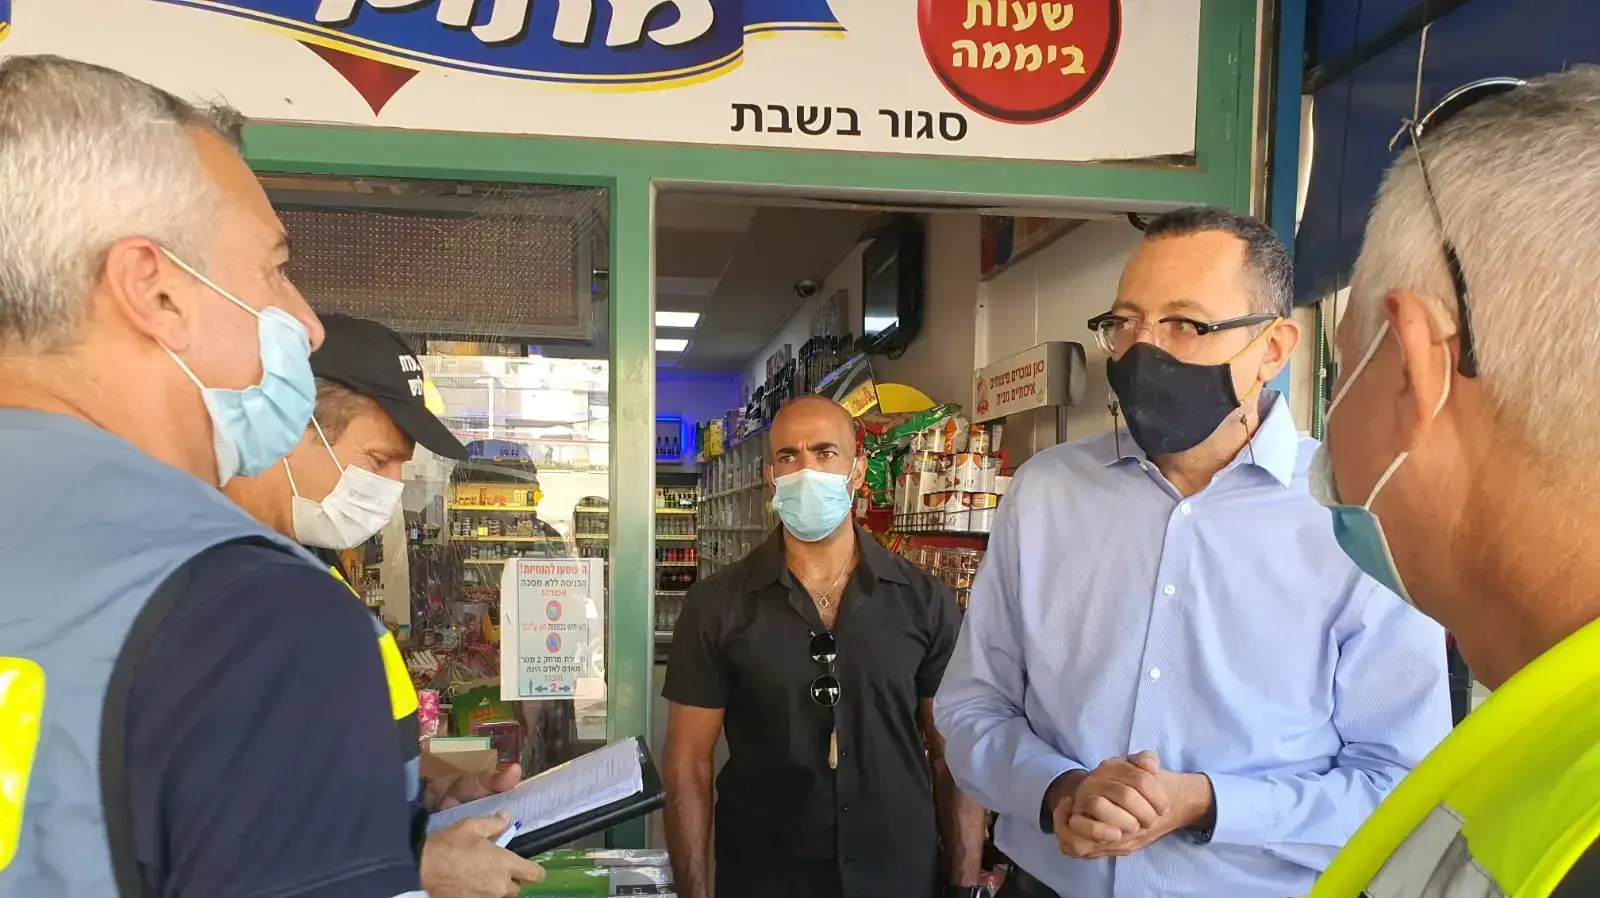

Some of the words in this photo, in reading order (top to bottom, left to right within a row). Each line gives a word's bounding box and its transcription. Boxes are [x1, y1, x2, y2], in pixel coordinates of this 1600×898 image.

[962, 0, 1074, 32] שעות
[952, 39, 1086, 76] ביממה
[731, 101, 861, 137] בשבת
[878, 107, 968, 141] סגור
[1012, 363, 1032, 382] נמכרים
[1033, 360, 1045, 379] כאן
[990, 372, 1011, 390] פיצוחים
[520, 579, 542, 587] מסכה
[544, 577, 559, 587] ללא
[561, 579, 587, 587] הכניסה
[541, 588, 567, 597] אסורה!
[543, 656, 562, 664] מרחק
[543, 664, 561, 673] לאדם
[550, 683, 557, 693] 2
